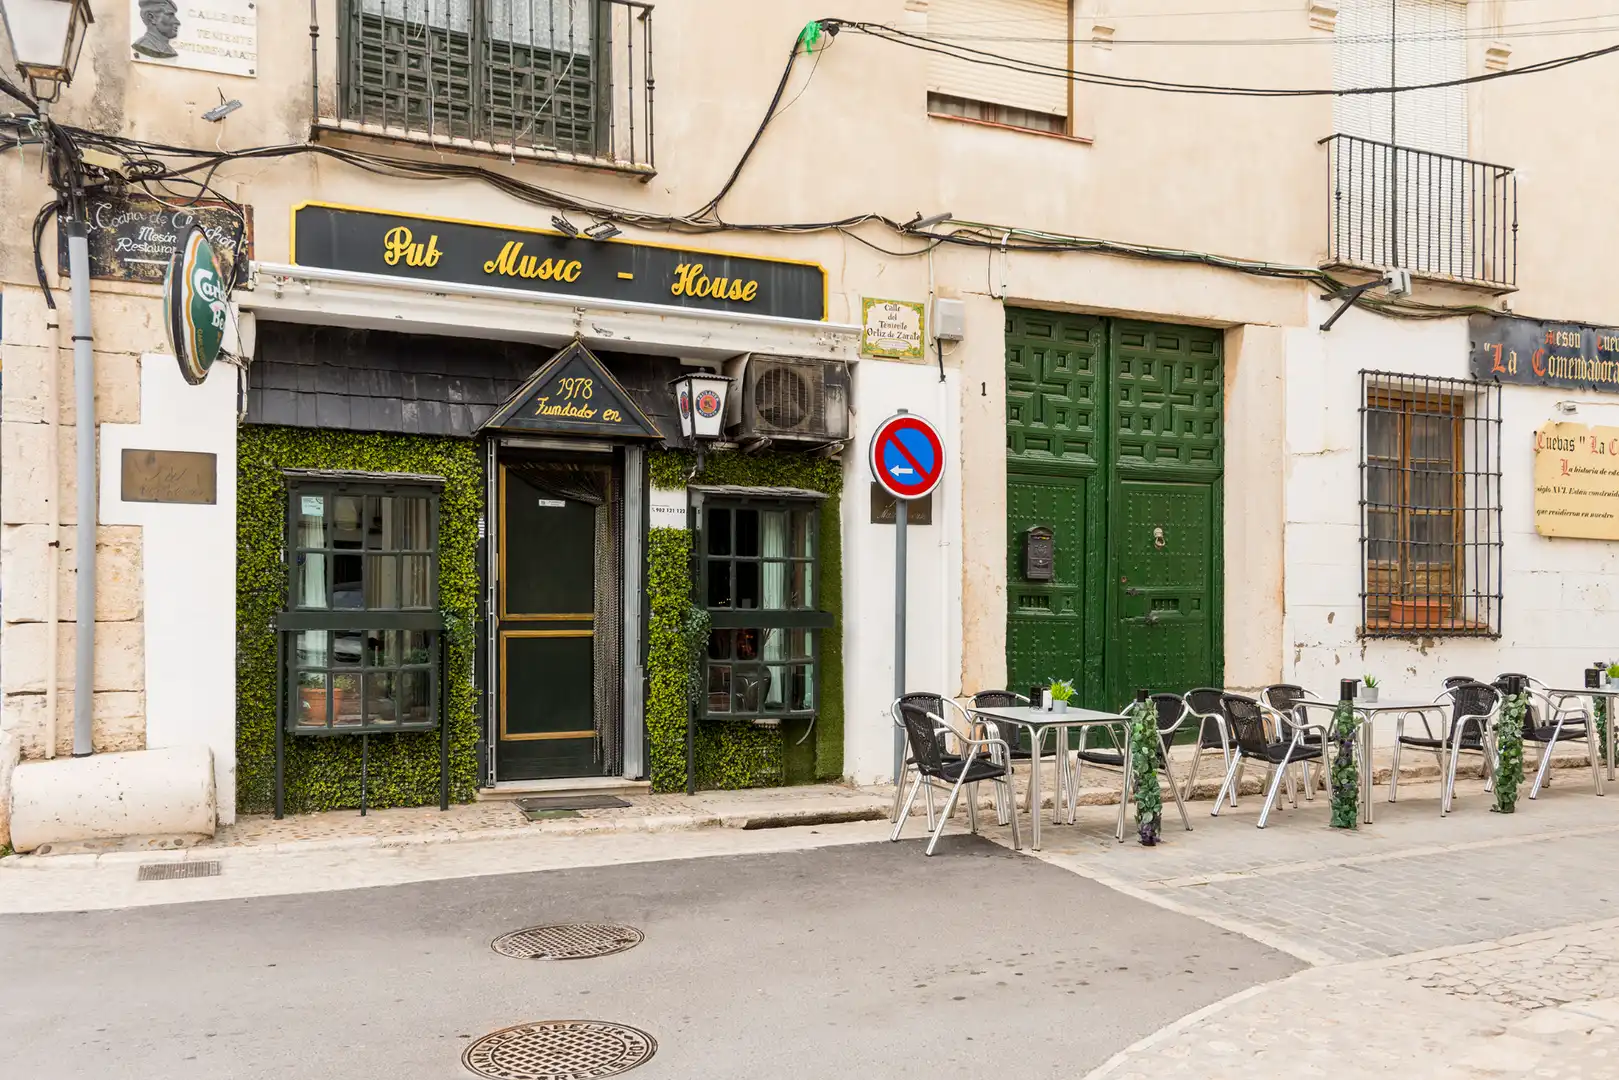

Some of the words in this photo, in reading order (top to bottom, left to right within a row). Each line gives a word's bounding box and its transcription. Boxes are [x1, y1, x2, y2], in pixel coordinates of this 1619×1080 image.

[188, 8, 227, 22] CALLE
[197, 28, 254, 46] TENIENTE
[96, 202, 147, 229] Cocina
[150, 207, 169, 225] de
[384, 225, 443, 268] Pub
[483, 240, 582, 283] Music
[671, 263, 758, 302] House
[884, 303, 901, 312] Calle
[887, 313, 897, 321] del
[878, 320, 907, 330] Teniente
[867, 328, 886, 338] Ortiz
[556, 377, 593, 400] 1978
[981, 382, 987, 396] 1
[535, 397, 597, 419] Fundado
[602, 408, 622, 422] en
[1534, 431, 1575, 452] Cuevas
[1574, 466, 1598, 475] historia
[1537, 485, 1551, 494] siglo
[1536, 509, 1548, 517] que
[513, 1023, 598, 1036] ISABEL
[485, 1033, 514, 1045] DE
[472, 1044, 501, 1073] CANAL
[554, 1045, 645, 1080] REGISTRO
